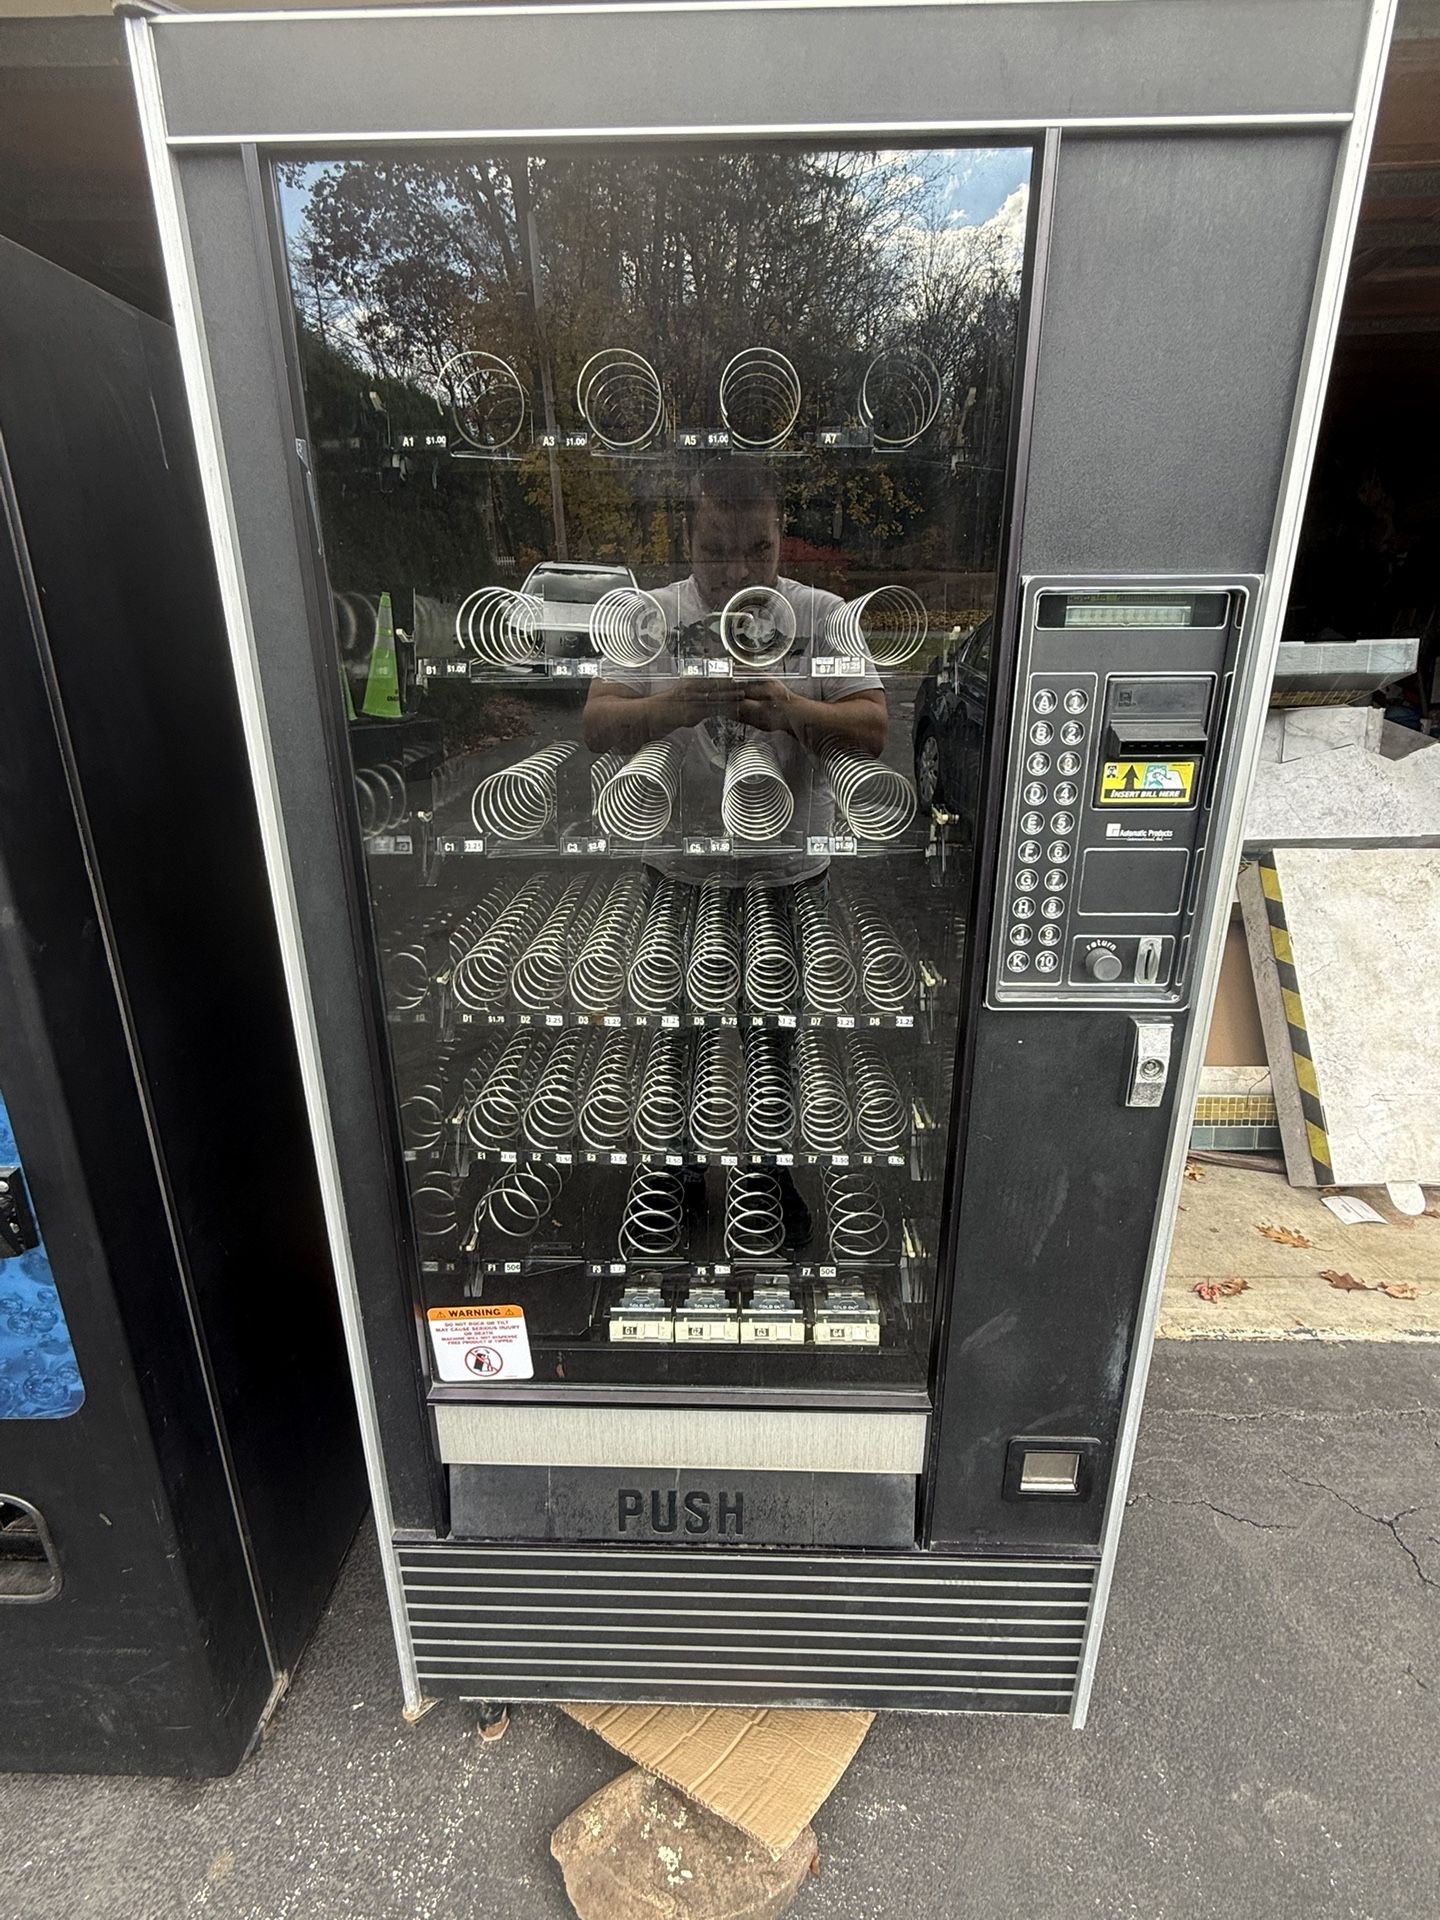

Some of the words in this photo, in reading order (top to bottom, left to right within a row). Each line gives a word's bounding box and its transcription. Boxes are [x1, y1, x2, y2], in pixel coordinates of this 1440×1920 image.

[402, 436, 414, 447] A1
[426, 436, 447, 445] $1.00
[543, 436, 555, 447] A3
[684, 435, 697, 446] A5
[708, 434, 729, 444] $1.00
[824, 433, 837, 444] A7
[426, 666, 437, 675] B1
[556, 666, 568, 675] B3
[687, 666, 699, 675] B5
[820, 665, 832, 674] B7
[1039, 696, 1049, 708] A
[1071, 696, 1080, 709] 1
[1036, 728, 1047, 738] B
[1068, 728, 1077, 738] 2
[1033, 759, 1043, 769] C
[1064, 758, 1073, 769] 3
[1030, 788, 1040, 799] D
[1061, 788, 1070, 799] 4
[1110, 790, 1140, 798] INSERT
[1027, 818, 1037, 828] E
[1057, 818, 1066, 828] 5
[1120, 829, 1147, 837] Automatic
[1148, 829, 1173, 837] Products
[444, 843, 455, 852] C1
[567, 843, 578, 853] C3
[690, 844, 701, 853] C5
[814, 843, 824, 852] C7
[1024, 846, 1034, 857] F
[1054, 846, 1063, 857] 6
[1021, 875, 1031, 885] G
[1052, 874, 1060, 885] 7
[1018, 901, 1029, 913] H
[1047, 902, 1056, 913] 8
[1016, 929, 1025, 940] J
[1045, 929, 1054, 940] 9
[1085, 939, 1117, 951] return
[1013, 955, 1023, 967] K
[1040, 955, 1053, 967] 10
[462, 1014, 472, 1023] D1
[521, 1015, 531, 1024] D2
[578, 1016, 588, 1025] D3
[637, 1016, 647, 1025] D4
[694, 1017, 704, 1026] D5
[753, 1017, 763, 1026] D6
[811, 1017, 822, 1026] D7
[870, 1017, 880, 1026] D8
[478, 1152, 486, 1160] E1
[532, 1153, 542, 1162] E2
[587, 1153, 596, 1162] E3
[642, 1155, 652, 1163] E4
[697, 1154, 706, 1163] E5
[752, 1155, 761, 1163] E6
[808, 1155, 817, 1163] E7
[863, 1155, 872, 1164] E8
[488, 1264, 496, 1272] F1
[507, 1263, 520, 1272] 50¢
[593, 1265, 601, 1273] F3
[698, 1267, 706, 1275] F5
[802, 1268, 811, 1276] F7
[821, 1268, 835, 1276] 50¢
[448, 1308, 501, 1318] WARNING
[691, 1328, 701, 1336] G2
[757, 1328, 767, 1336] G3
[618, 1489, 743, 1535] PUSH
